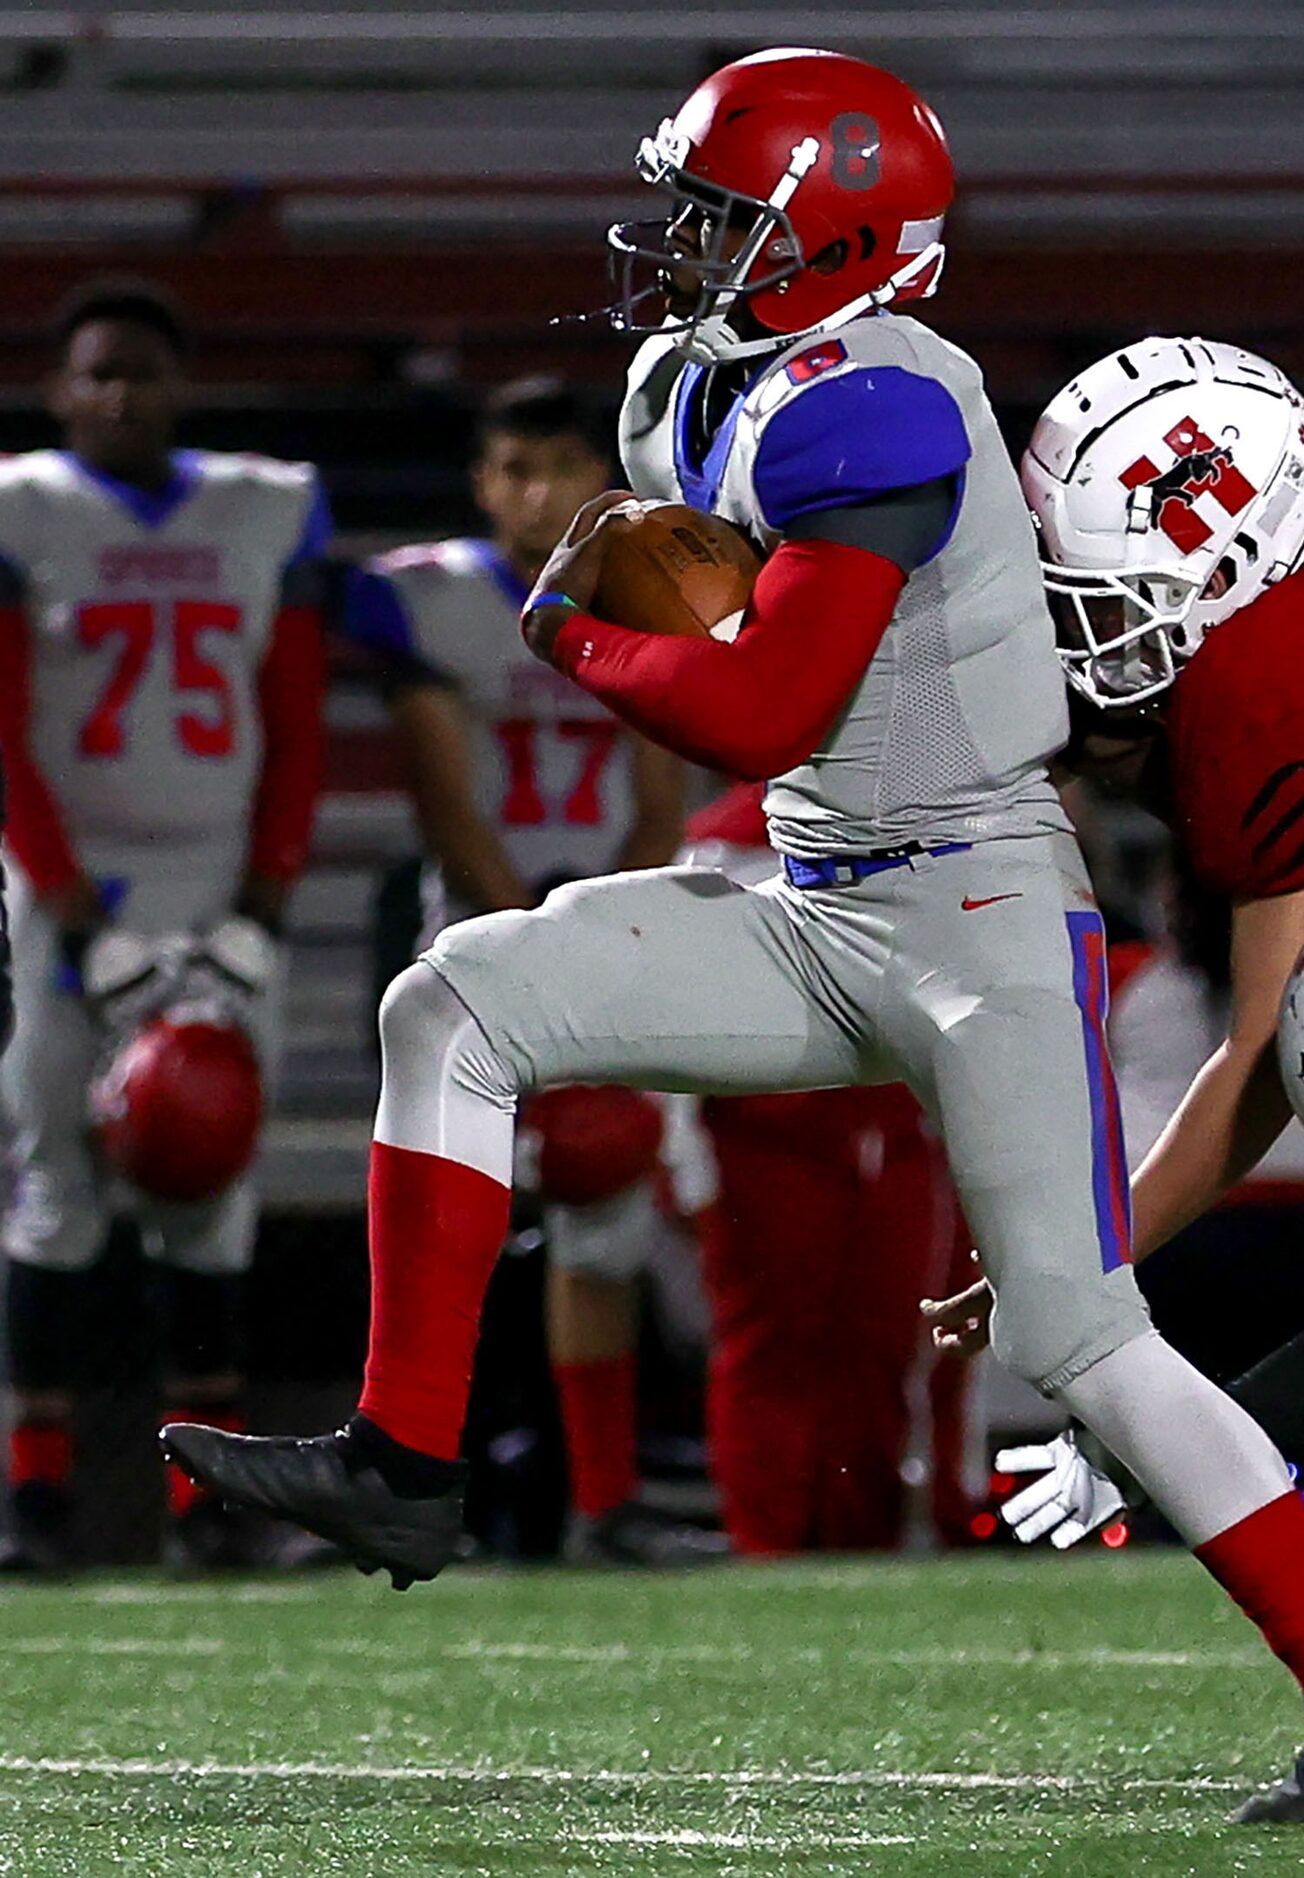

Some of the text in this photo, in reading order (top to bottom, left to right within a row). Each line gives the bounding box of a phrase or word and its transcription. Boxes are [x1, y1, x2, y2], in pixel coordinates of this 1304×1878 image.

[830, 111, 880, 192] 8
[75, 598, 243, 757] 75
[493, 717, 620, 826] 17
